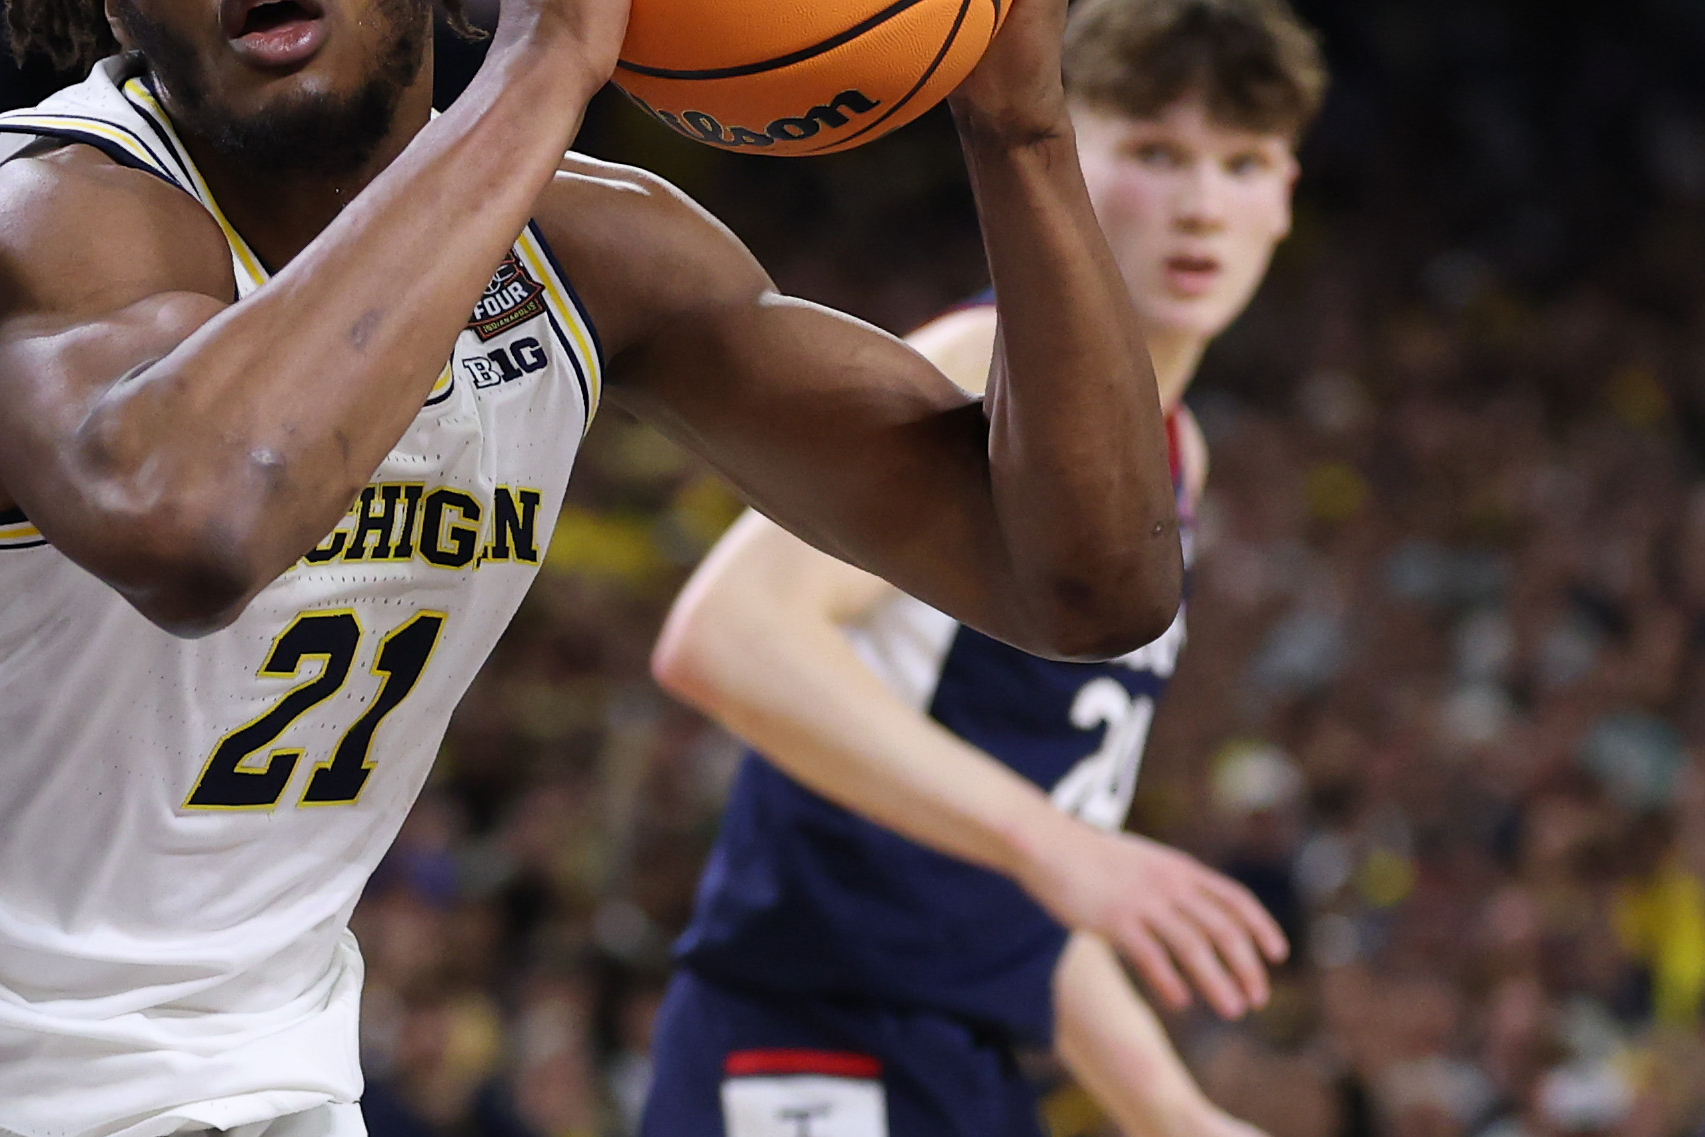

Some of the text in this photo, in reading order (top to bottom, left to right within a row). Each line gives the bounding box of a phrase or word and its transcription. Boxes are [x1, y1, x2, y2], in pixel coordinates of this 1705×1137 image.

[473, 283, 528, 321] FOUR
[482, 300, 538, 334] INDIANAPOLIS
[182, 607, 448, 810] 21
